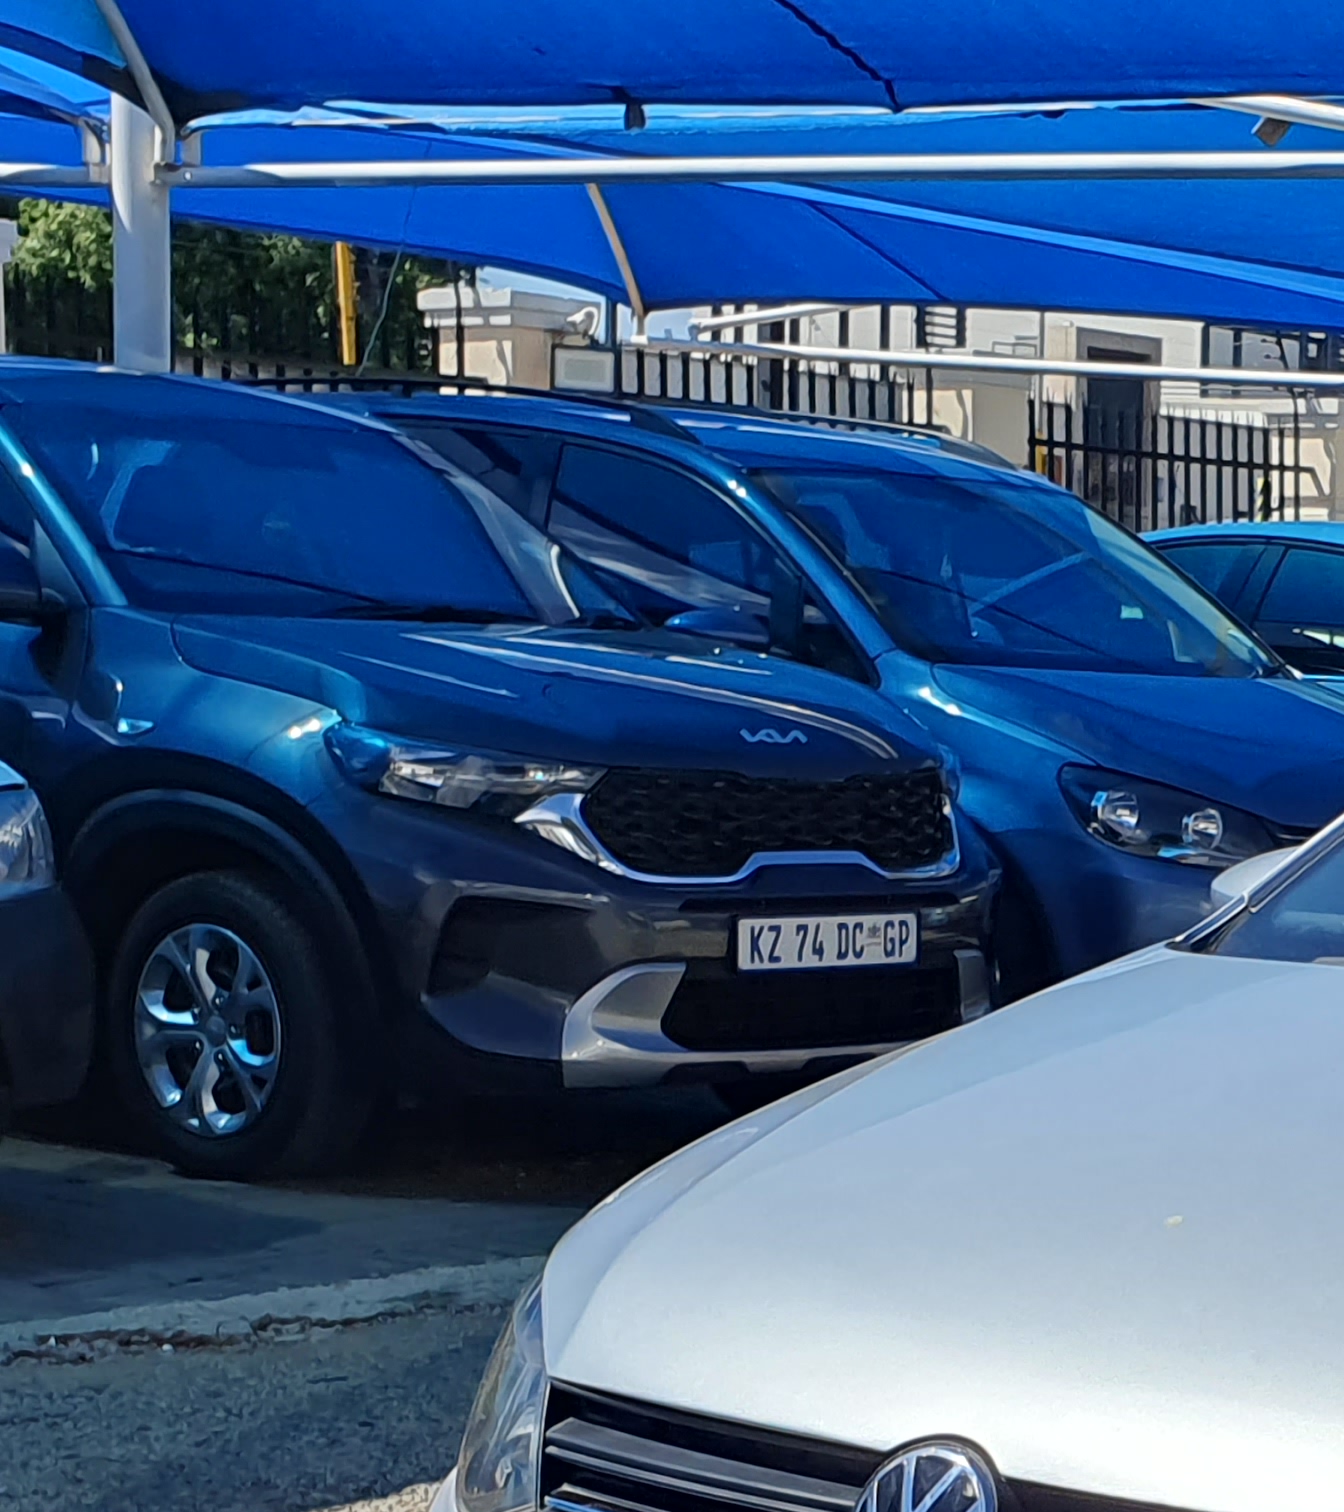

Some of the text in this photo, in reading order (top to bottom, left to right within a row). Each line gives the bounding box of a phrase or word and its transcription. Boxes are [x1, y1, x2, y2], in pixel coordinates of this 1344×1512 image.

[750, 919, 911, 964] KZ 74 DC GP
